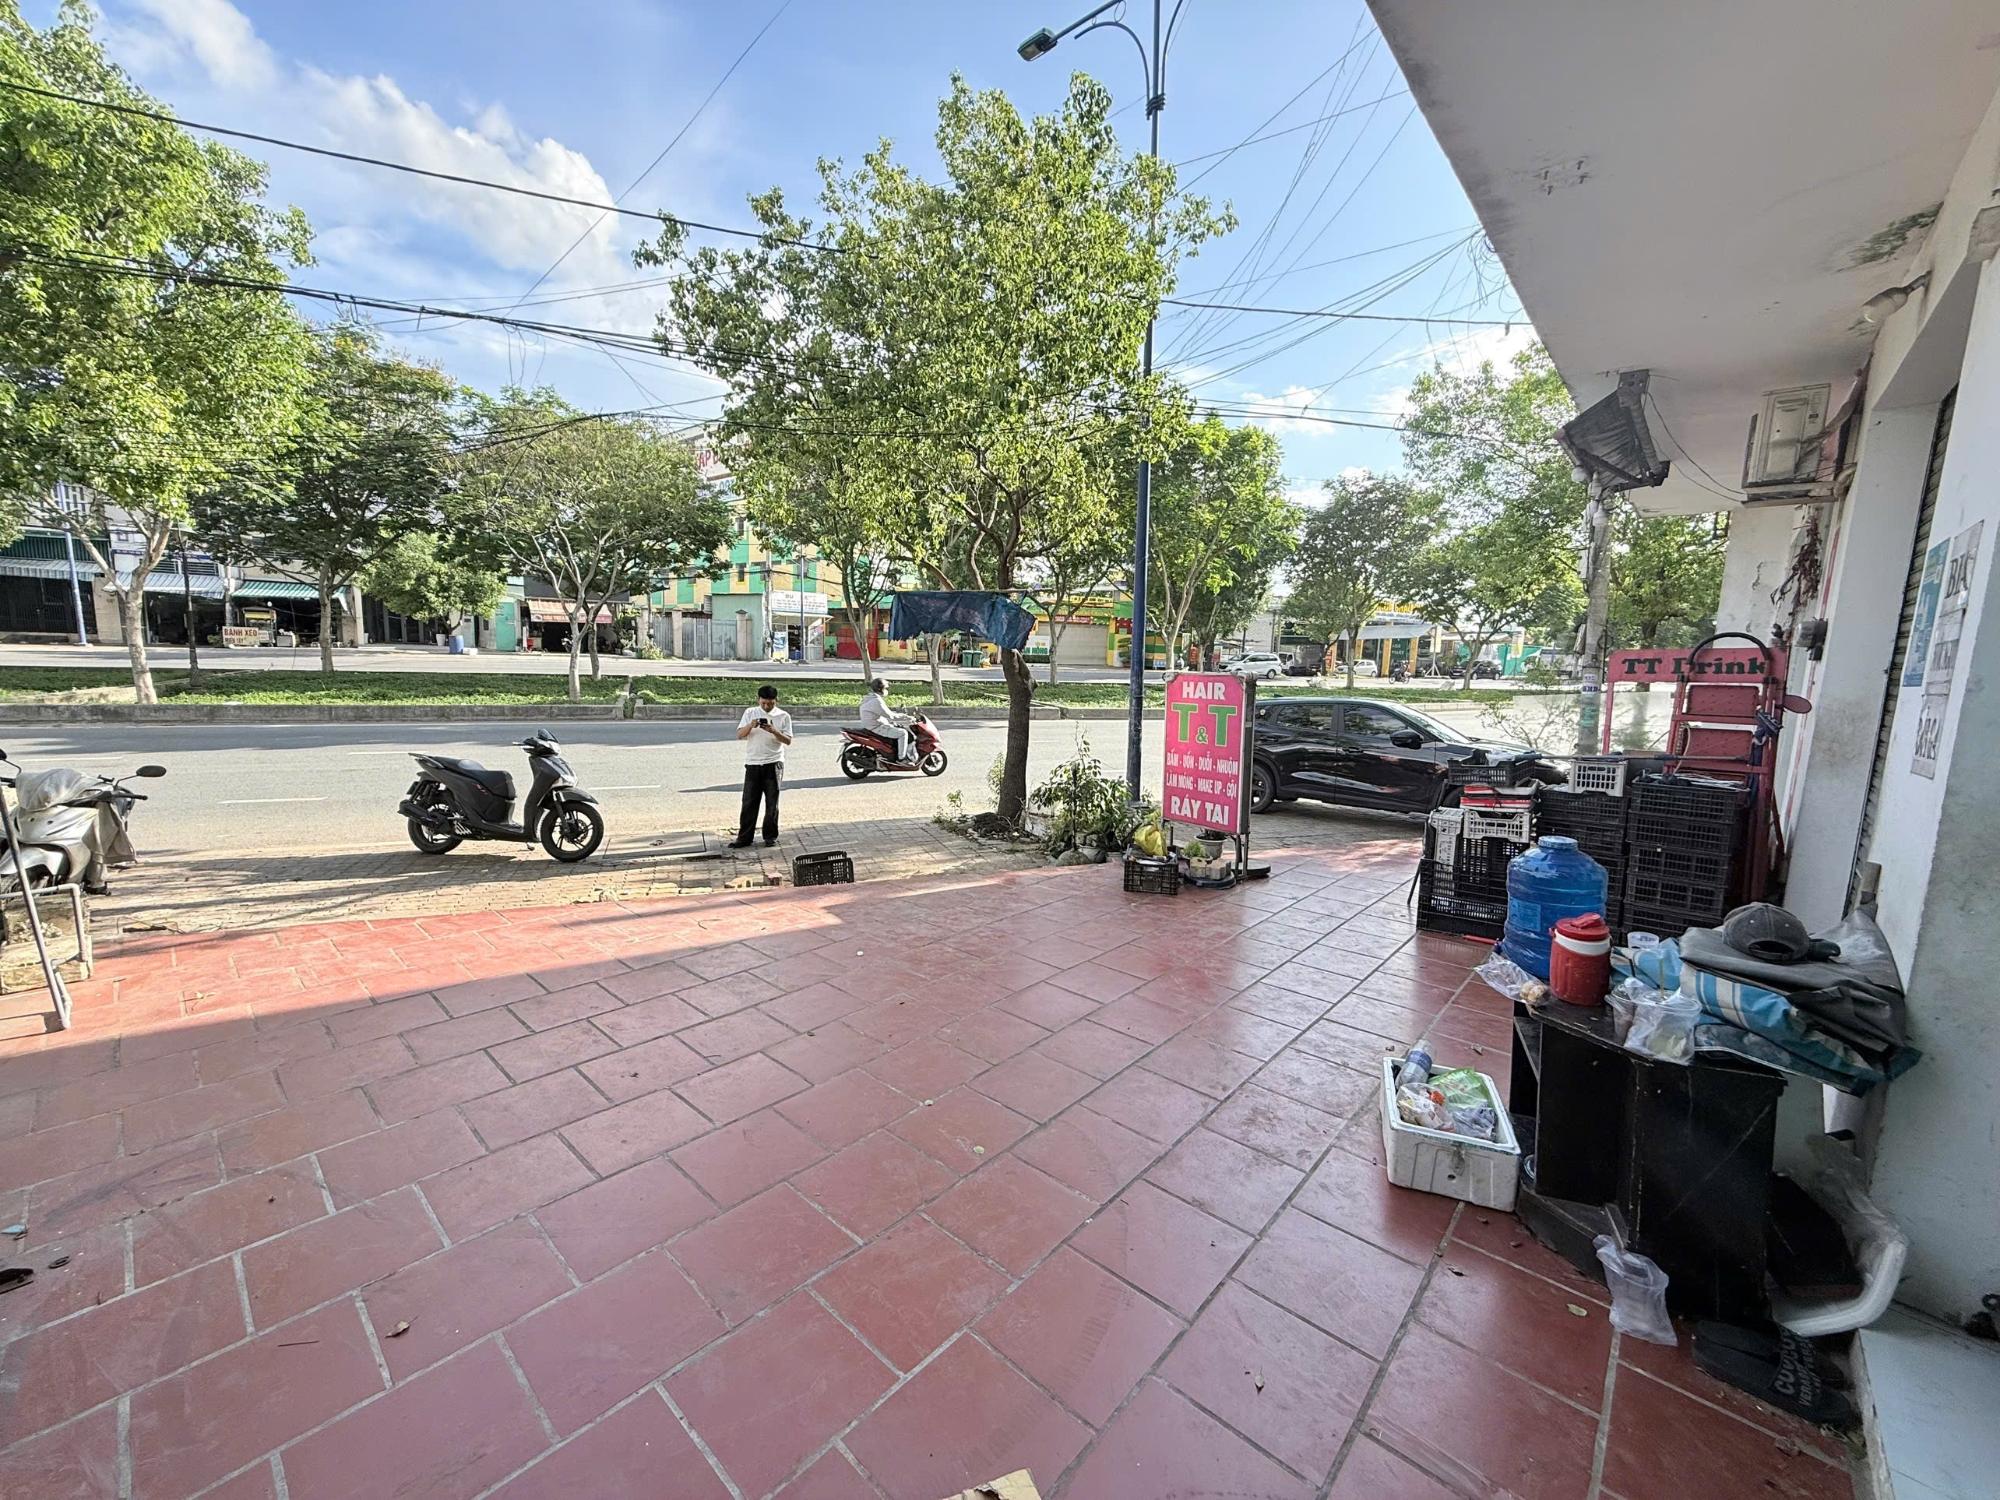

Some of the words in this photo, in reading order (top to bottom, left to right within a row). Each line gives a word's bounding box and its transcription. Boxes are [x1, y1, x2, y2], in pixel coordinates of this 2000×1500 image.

[1622, 657, 1663, 674] TT
[1182, 681, 1226, 700] HAIR
[1198, 777, 1213, 794] MAKE
[1214, 780, 1223, 795] UP
[1170, 794, 1202, 820] RÁY
[1204, 802, 1229, 826] TAI
